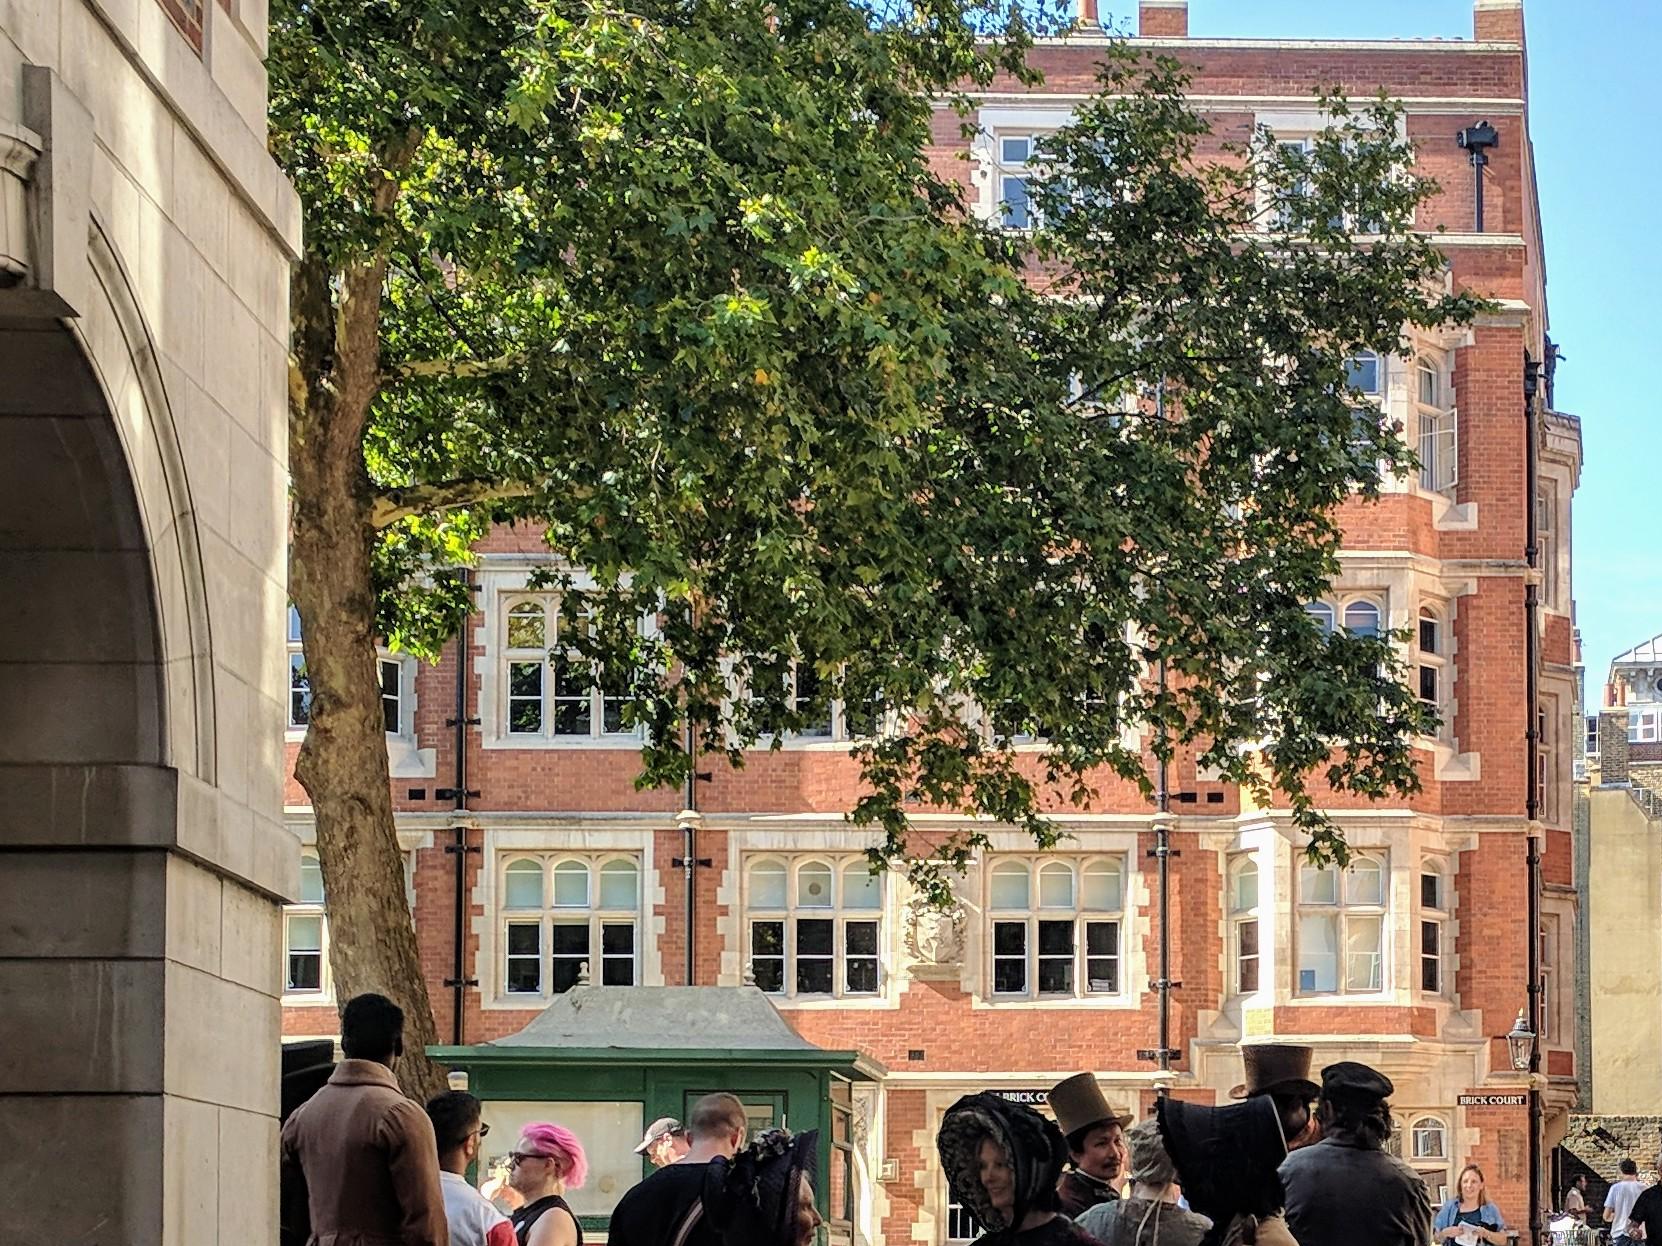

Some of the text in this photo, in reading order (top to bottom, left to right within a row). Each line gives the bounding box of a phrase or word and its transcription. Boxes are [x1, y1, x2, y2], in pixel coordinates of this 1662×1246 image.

[1002, 1092, 1036, 1103] BRICK
[1459, 1095, 1524, 1105] BRICK COURT
